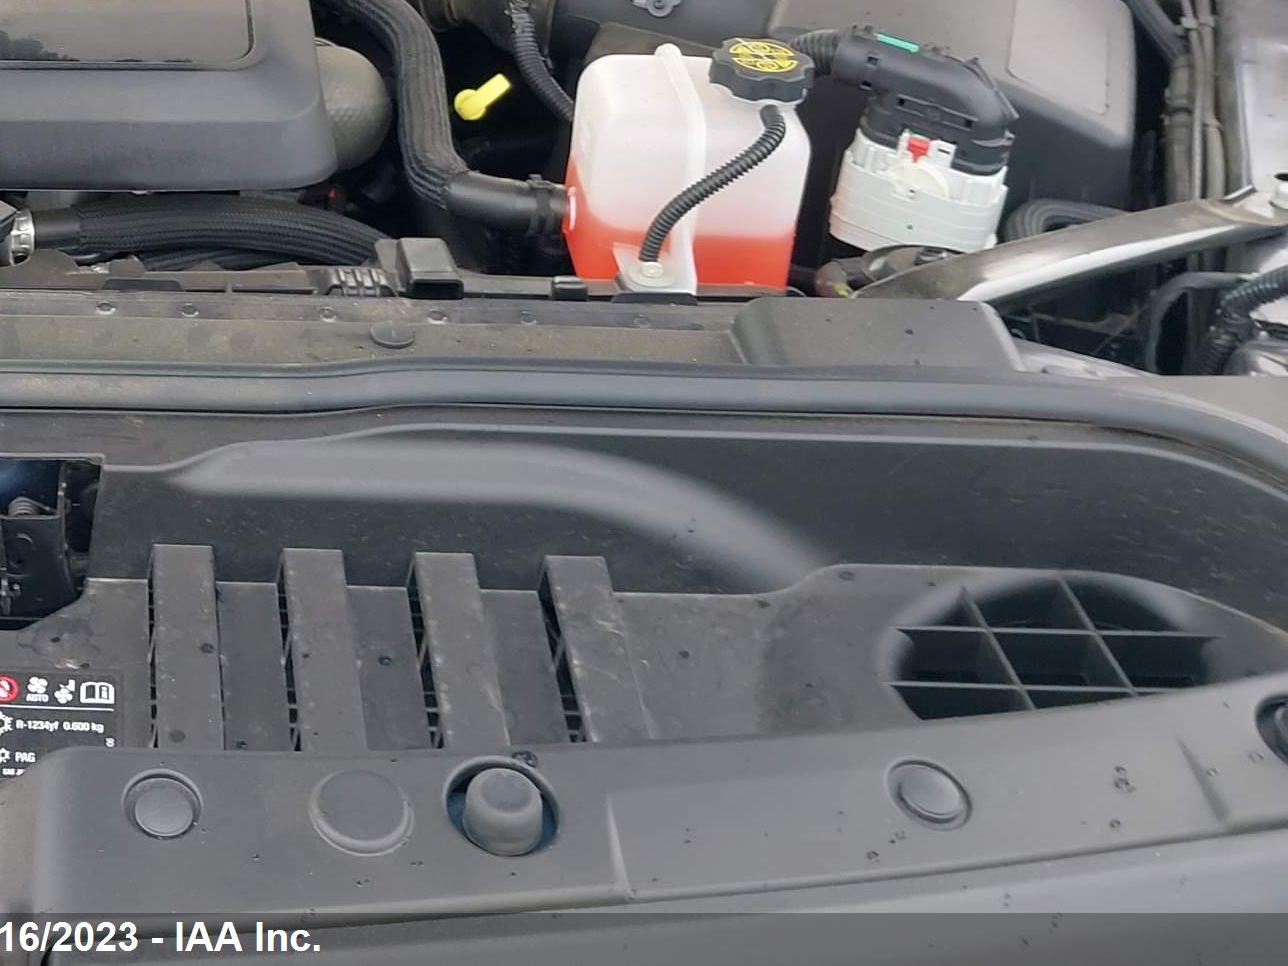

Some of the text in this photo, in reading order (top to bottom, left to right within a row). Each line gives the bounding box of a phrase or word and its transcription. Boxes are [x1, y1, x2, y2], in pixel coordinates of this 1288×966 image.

[26, 693, 49, 702] AUTO
[16, 720, 59, 732] R-1234yf
[91, 722, 105, 734] kg
[15, 752, 36, 763] PAG
